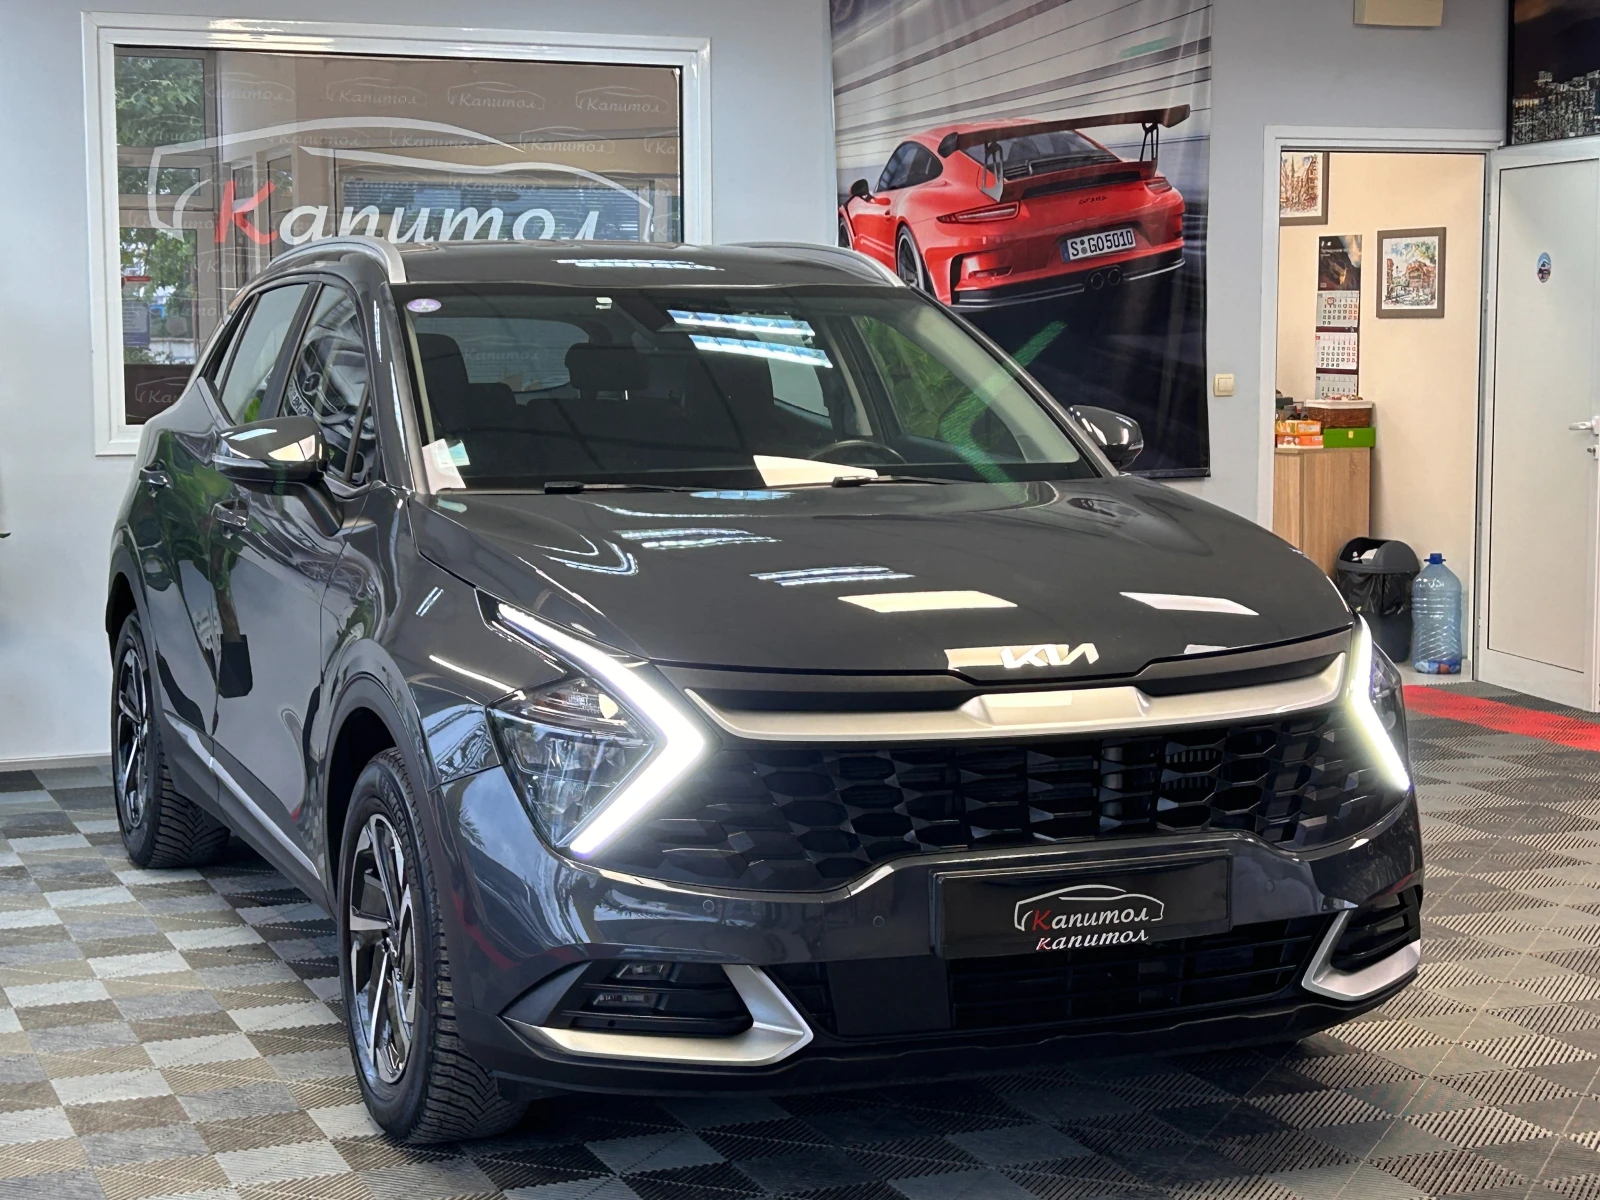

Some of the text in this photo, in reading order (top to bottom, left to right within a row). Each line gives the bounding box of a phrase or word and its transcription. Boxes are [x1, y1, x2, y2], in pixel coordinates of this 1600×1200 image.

[458, 92, 537, 109] Капитол
[586, 97, 661, 114] Капитол
[214, 180, 600, 245] Капитол
[1000, 642, 1100, 669] KIA
[1031, 907, 1150, 931] Капитол
